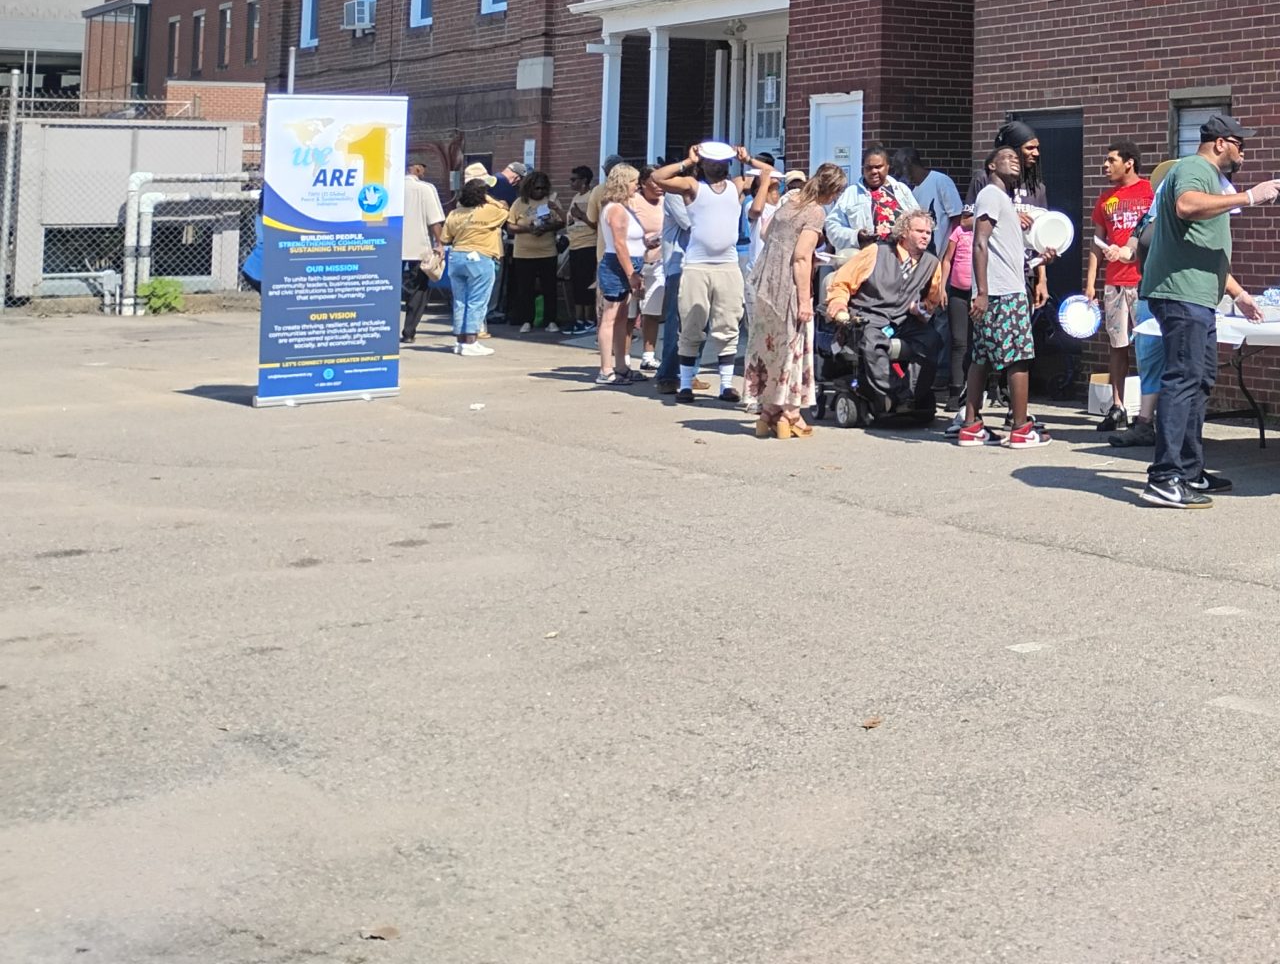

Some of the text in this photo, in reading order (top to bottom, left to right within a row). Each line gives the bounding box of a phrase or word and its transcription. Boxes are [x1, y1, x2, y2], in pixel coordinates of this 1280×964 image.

[292, 145, 333, 166] we
[312, 128, 386, 221] ARE 1
[300, 234, 335, 242] BUILDING
[278, 238, 387, 248] STRENGTHENING COMMUNITIES.
[306, 264, 359, 273] OUR MISSION
[272, 282, 306, 290] community
[335, 286, 366, 294] implement
[309, 313, 327, 321] OUR
[353, 332, 381, 340] physically,
[329, 339, 367, 347] economically.
